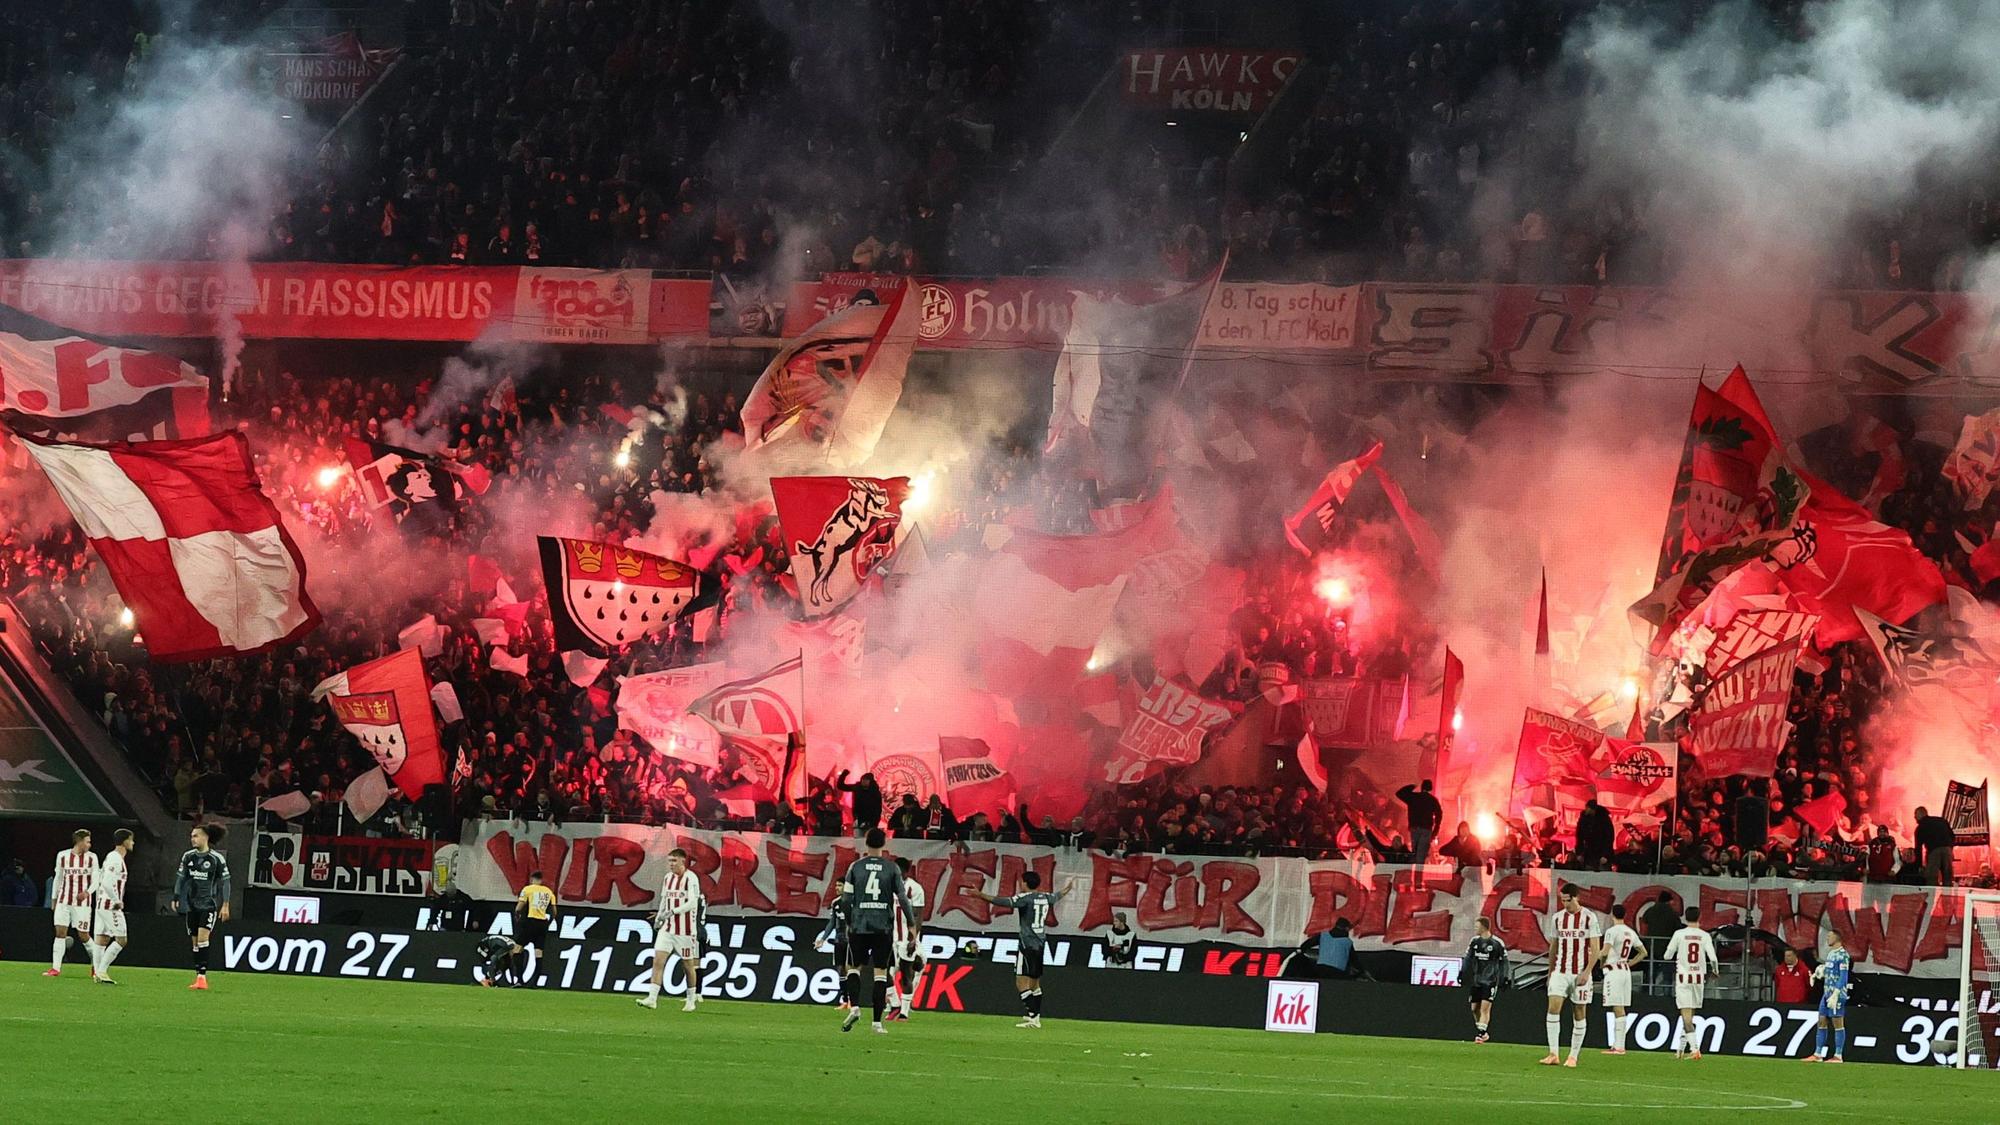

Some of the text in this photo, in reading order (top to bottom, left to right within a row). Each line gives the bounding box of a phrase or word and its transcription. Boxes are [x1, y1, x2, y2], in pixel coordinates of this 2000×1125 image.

[286, 59, 323, 77] HANS
[1128, 53, 1297, 93] HAWKS
[1171, 84, 1253, 112] KÖLN
[282, 278, 493, 321] RASSISMUS
[1245, 288, 1280, 317] Tag
[1288, 288, 1347, 312] schuf
[1218, 318, 1253, 340] den
[1278, 319, 1302, 342] FC
[1305, 313, 1350, 342] Köln
[486, 830, 656, 908] WIR
[1079, 852, 1264, 938] FÜR
[1303, 869, 1465, 946] DIE
[865, 871, 882, 901] 4
[1620, 939, 1631, 959] 6
[1688, 942, 1700, 964] 8
[224, 935, 327, 974] vom
[339, 932, 416, 980] 27.
[772, 955, 840, 1004] be
[1272, 988, 1312, 1026] kik
[1605, 1011, 1726, 1053] vom
